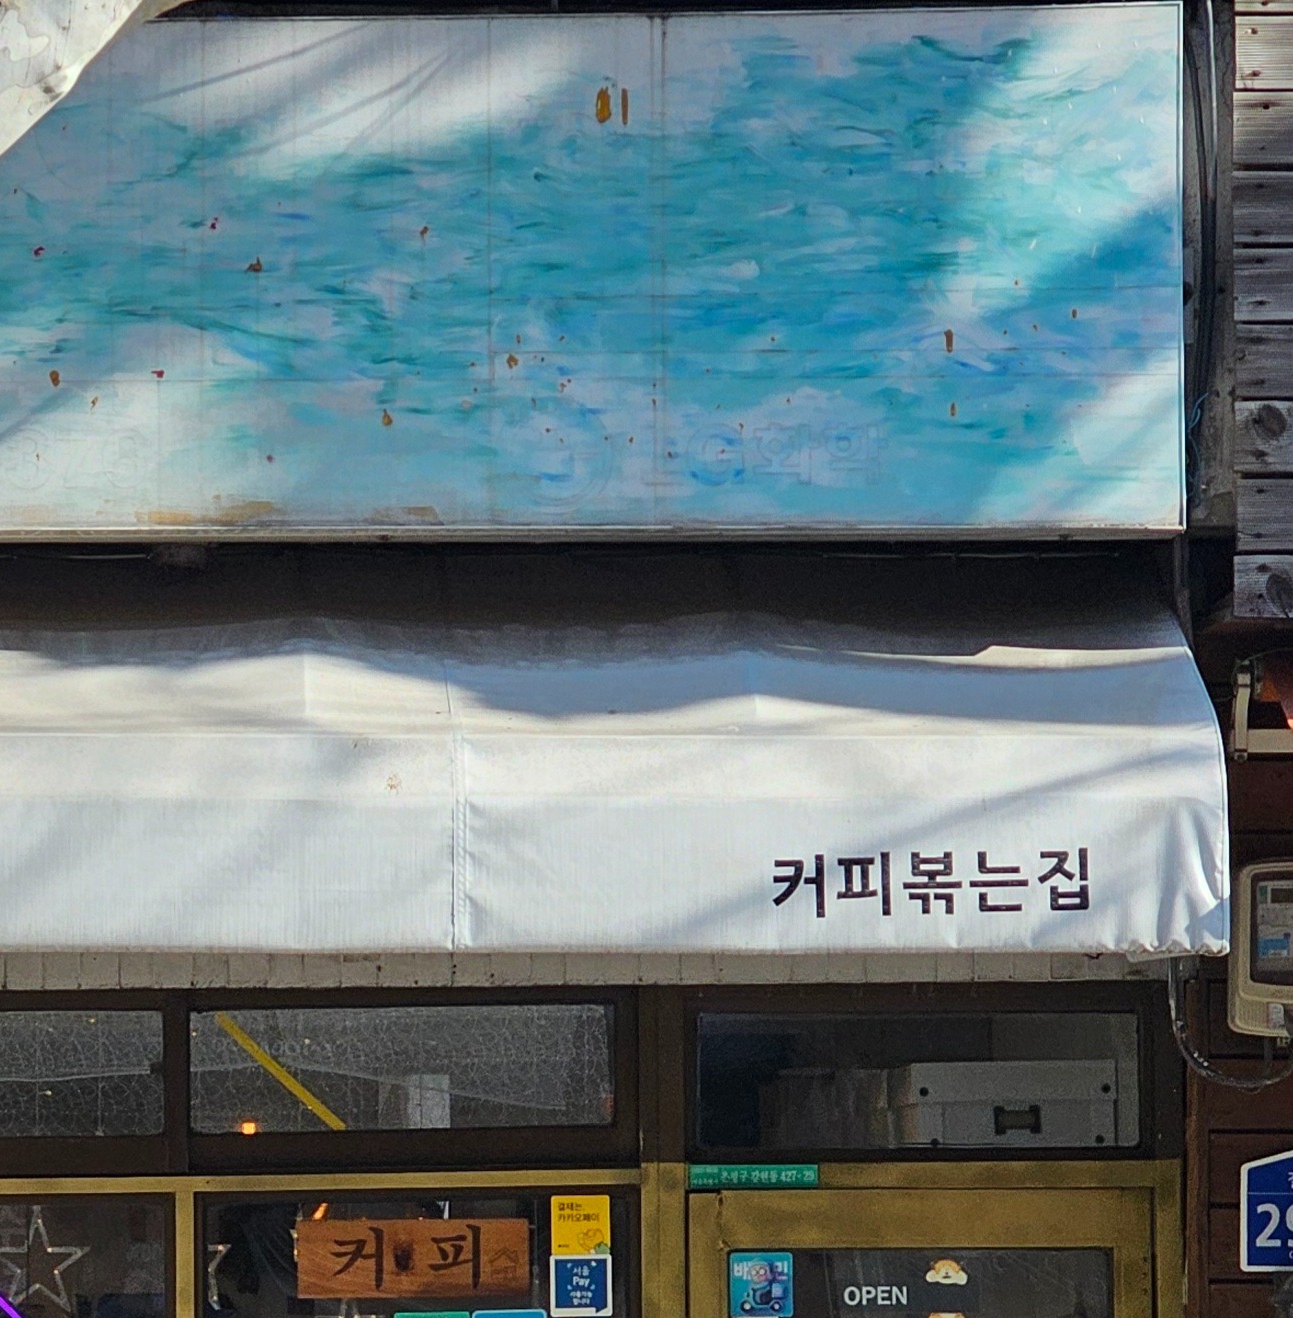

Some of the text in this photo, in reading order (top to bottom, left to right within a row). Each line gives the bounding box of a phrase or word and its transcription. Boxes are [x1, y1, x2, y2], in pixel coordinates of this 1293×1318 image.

[772, 847, 1091, 918] 커피볶는집
[557, 1212, 600, 1223] 카카오페이
[1255, 1203, 1293, 1247] 2
[330, 1224, 482, 1292] 커피
[572, 1275, 591, 1288] Pay
[843, 1286, 908, 1306] OPEN
